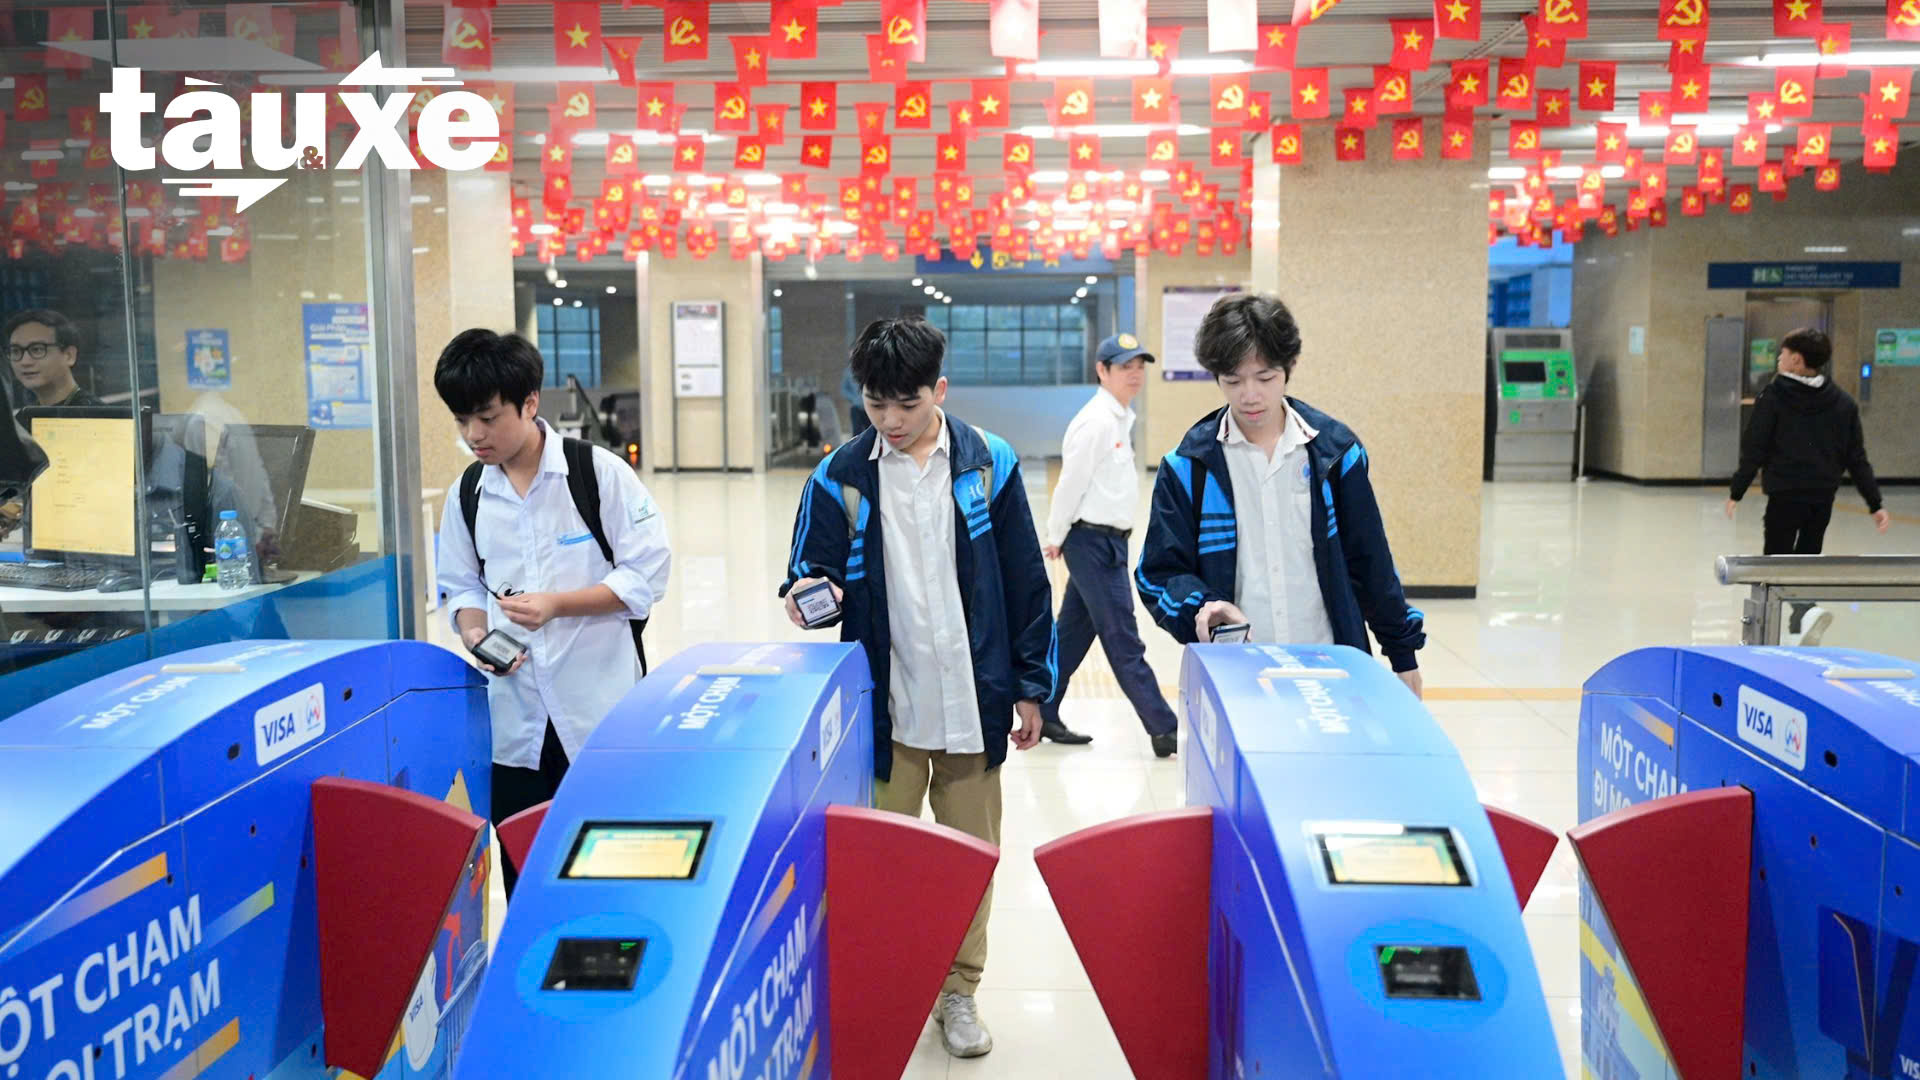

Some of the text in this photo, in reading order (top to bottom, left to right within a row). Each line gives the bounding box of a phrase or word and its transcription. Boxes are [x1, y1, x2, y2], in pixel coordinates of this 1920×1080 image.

[261, 713, 296, 747] VISA
[1601, 720, 1634, 780] MỘT
[1743, 702, 1773, 740] VISA
[1594, 768, 1609, 814] ĐI
[74, 893, 202, 1015] CHẠM
[760, 903, 807, 1028] CHẠM
[103, 957, 222, 1080] TRẠM
[409, 994, 423, 1023] VISA
[772, 968, 813, 1080] TRẠM
